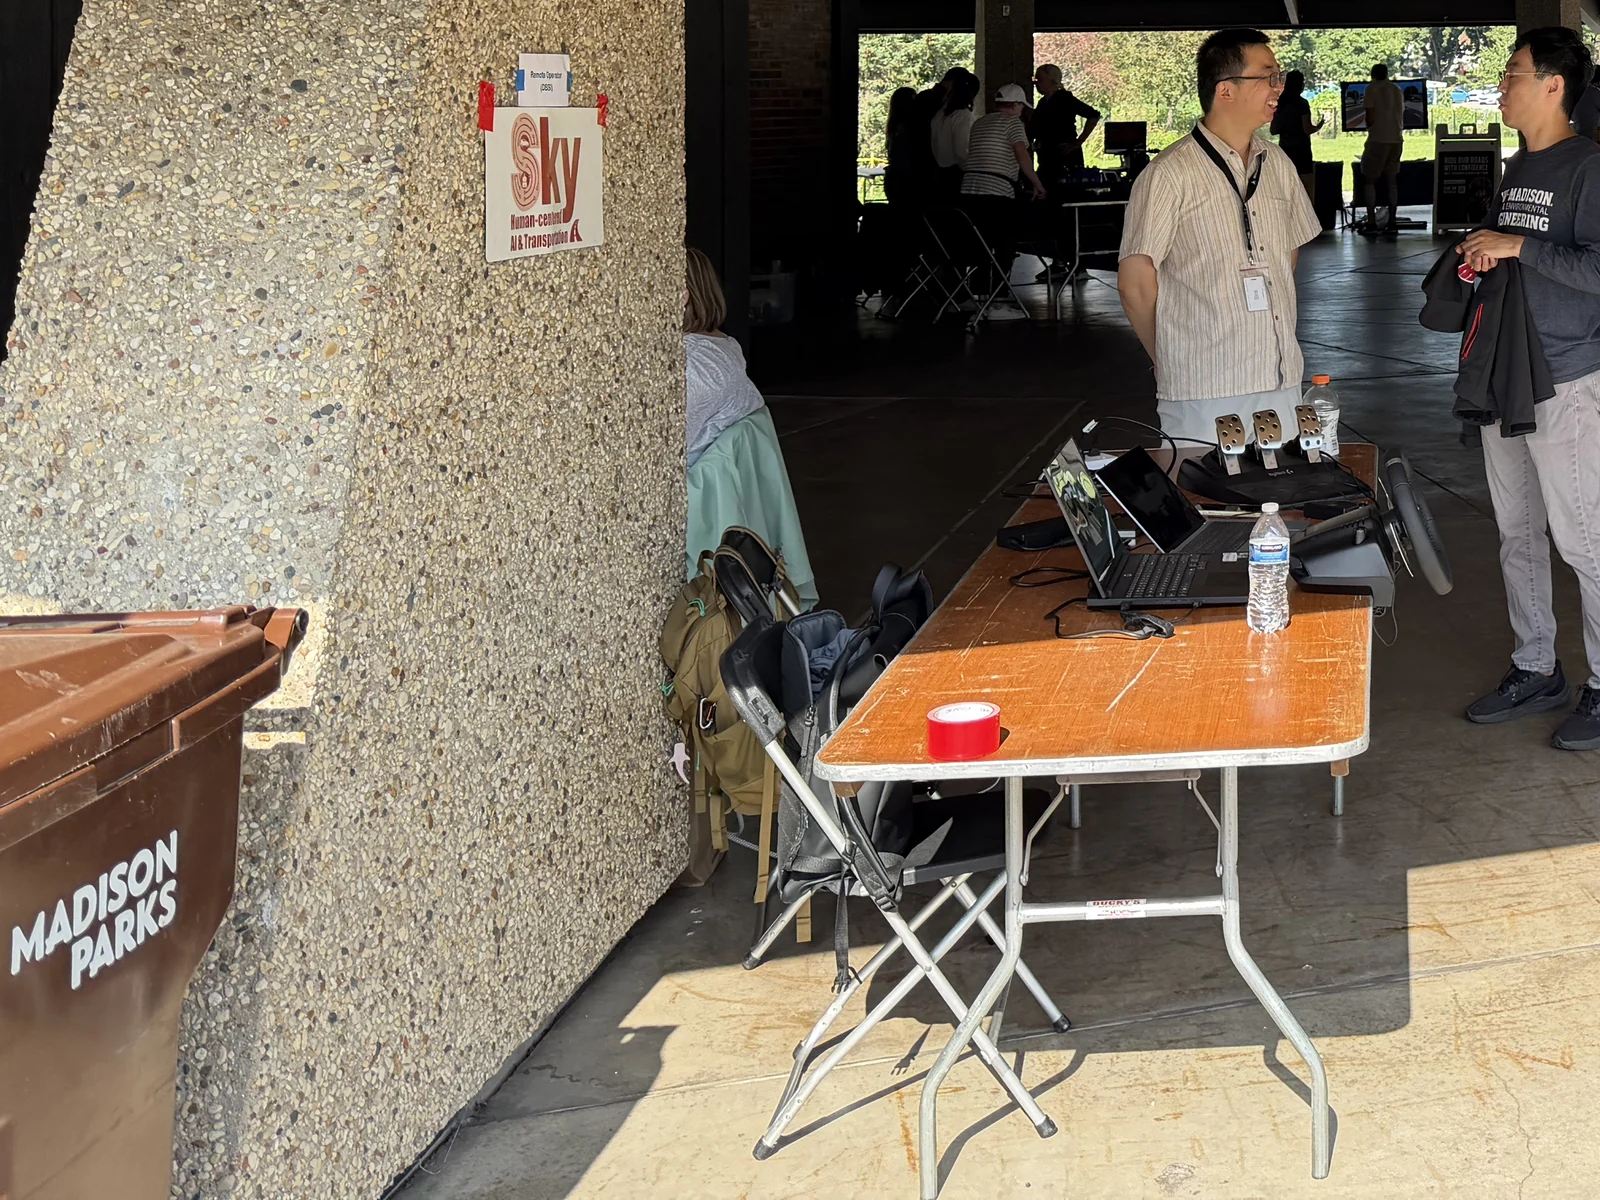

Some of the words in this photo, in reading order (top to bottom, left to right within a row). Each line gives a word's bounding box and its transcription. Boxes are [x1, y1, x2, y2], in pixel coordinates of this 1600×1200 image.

[530, 70, 545, 79] Remote
[510, 112, 582, 224] Sky
[517, 234, 524, 251] &
[10, 829, 178, 977] MADISON
[70, 878, 177, 991] PARKS
